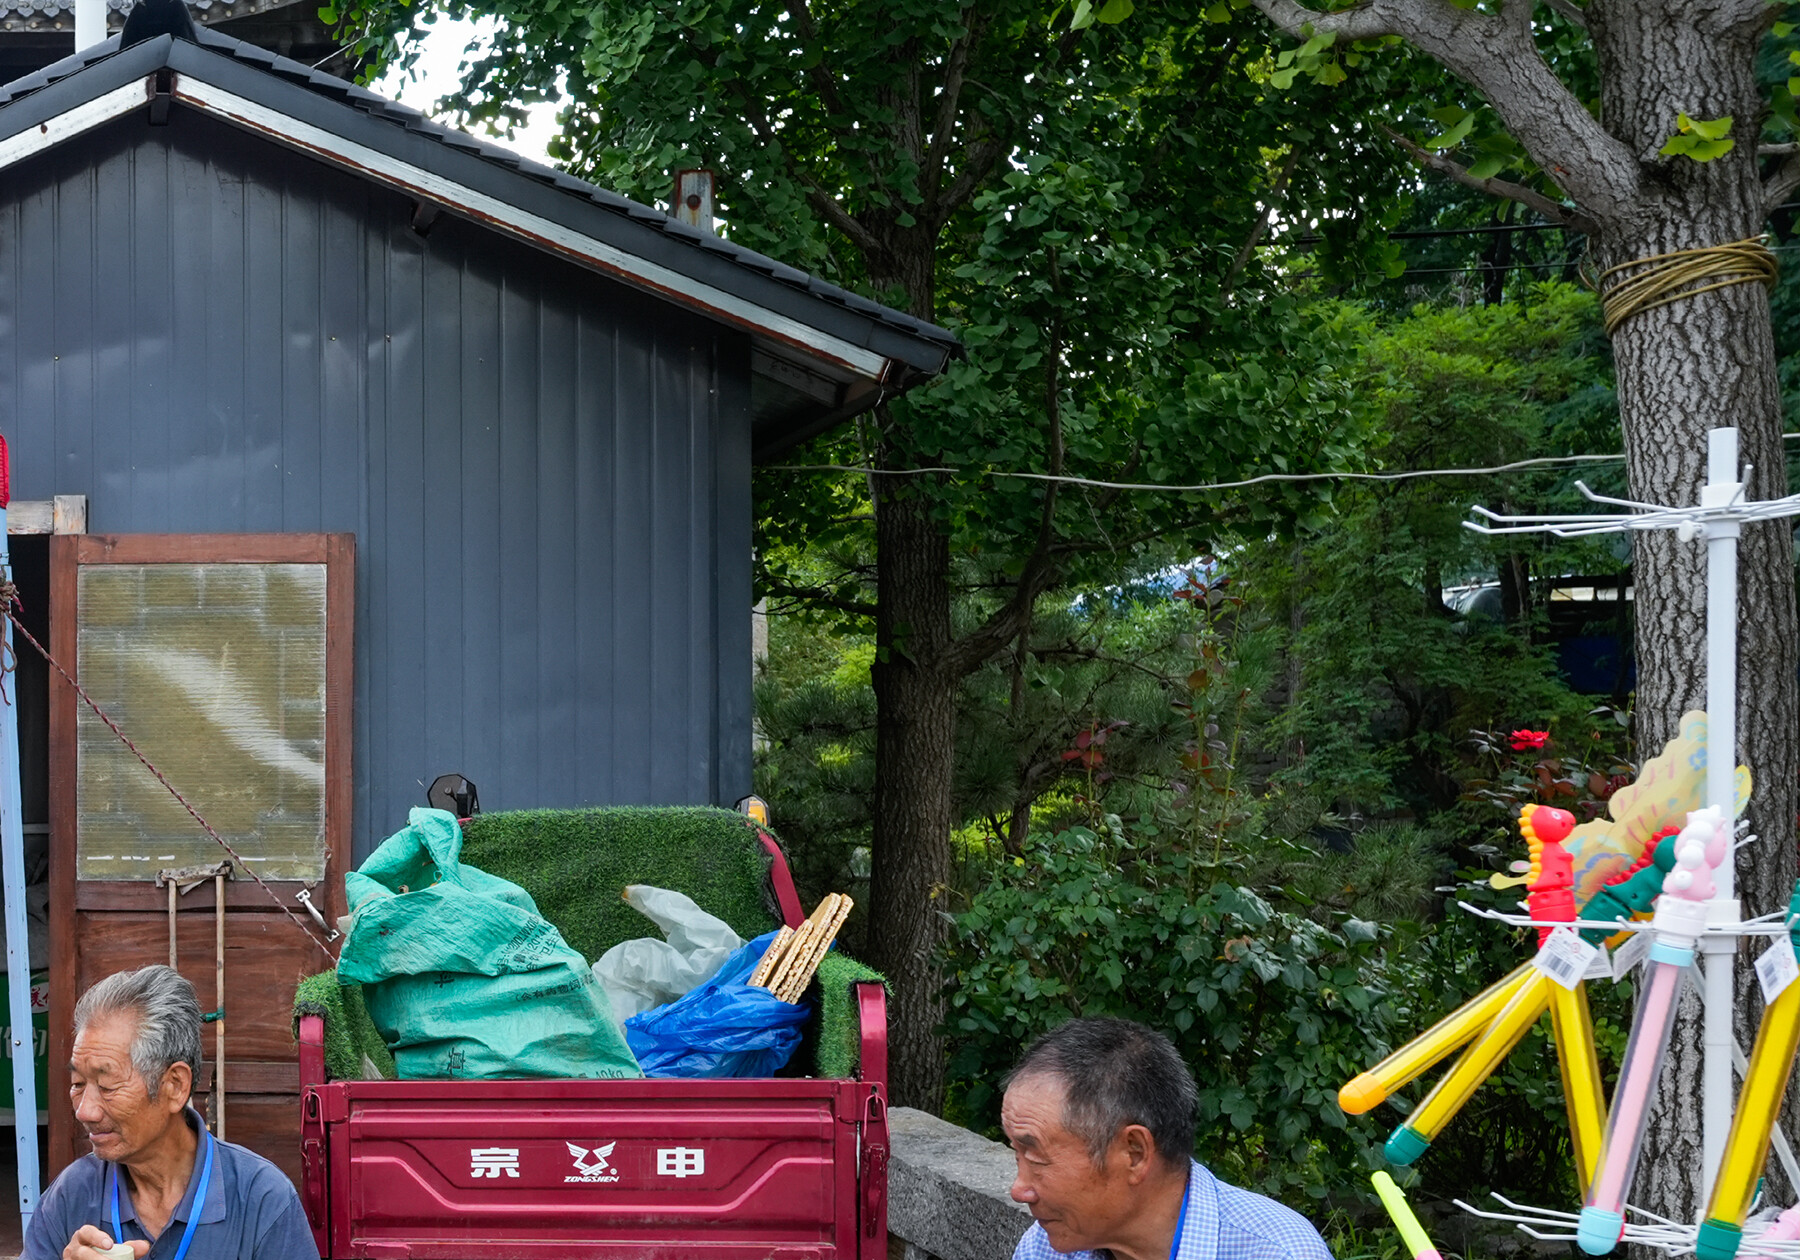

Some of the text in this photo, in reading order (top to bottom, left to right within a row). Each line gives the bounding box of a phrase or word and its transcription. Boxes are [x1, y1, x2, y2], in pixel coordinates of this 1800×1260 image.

[470, 1147, 705, 1179] 宗 申
[563, 1175, 620, 1183] ZONGSHEN
